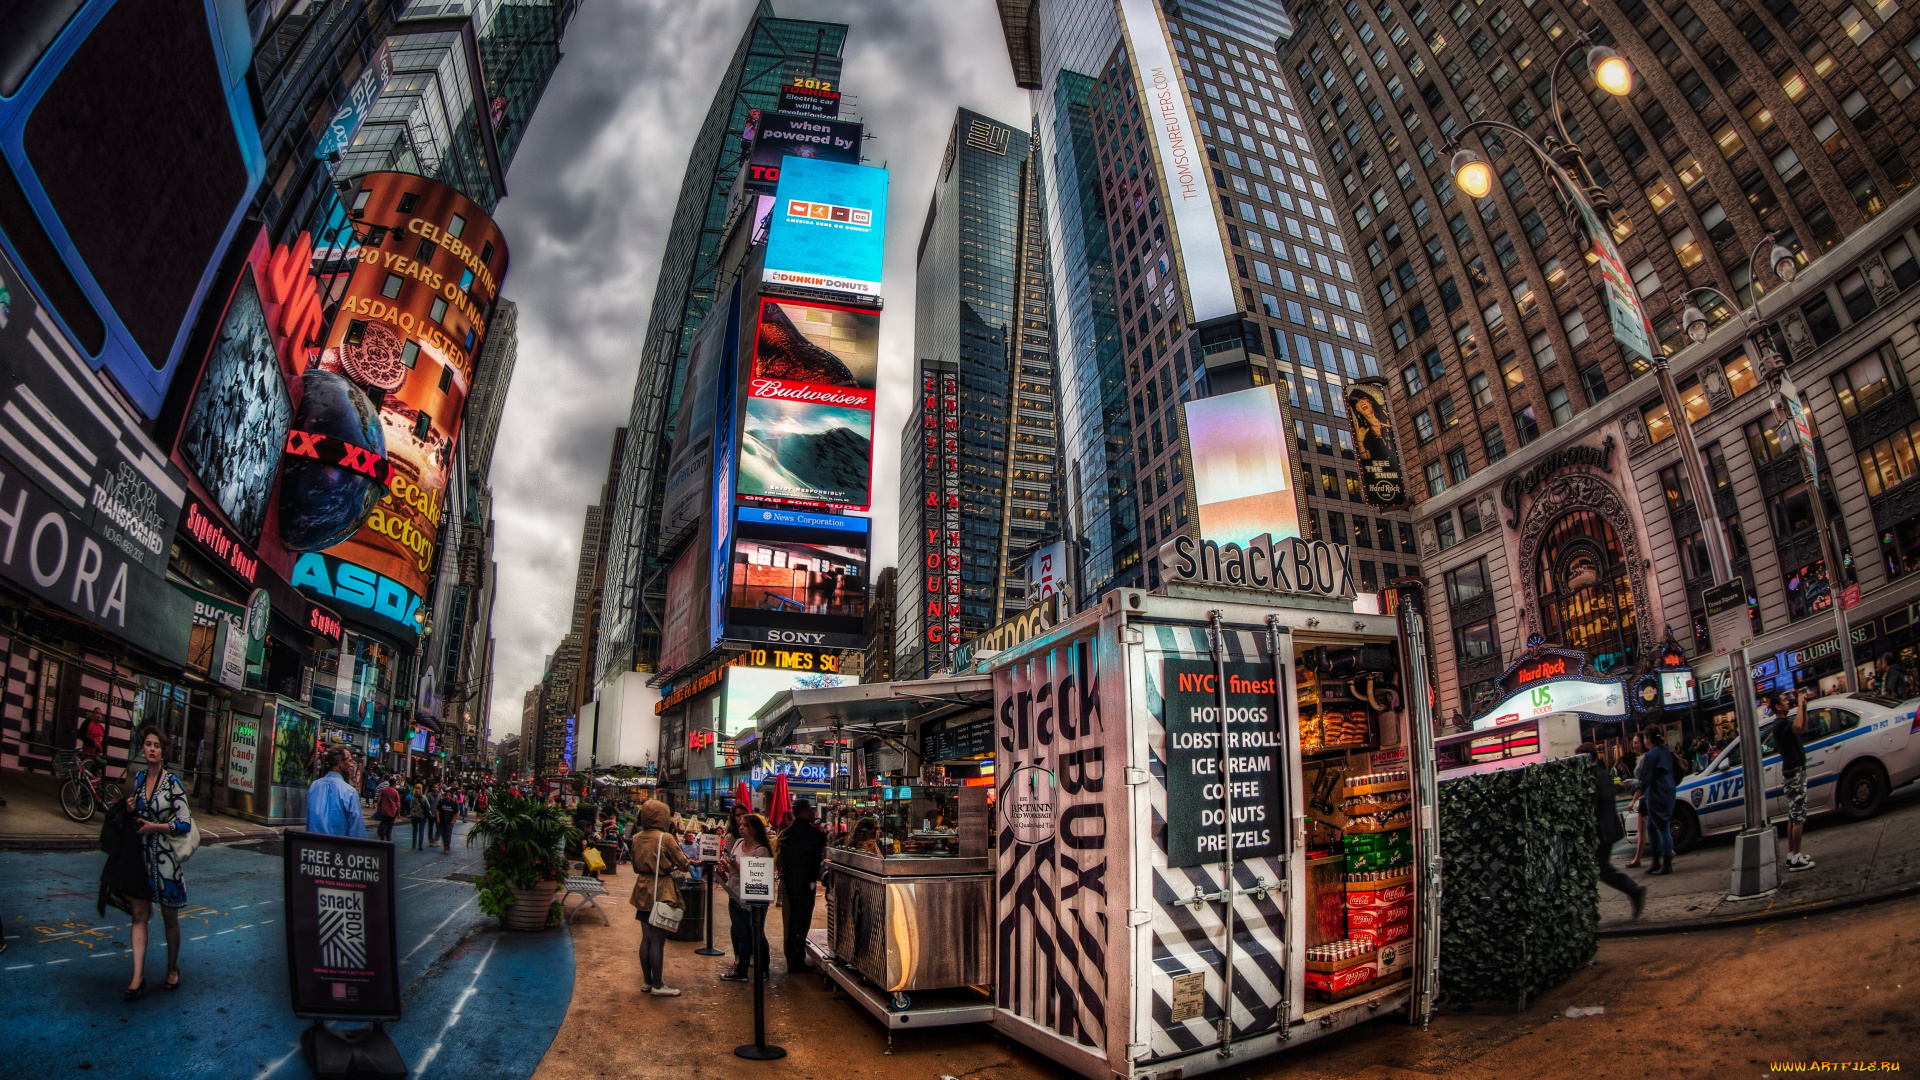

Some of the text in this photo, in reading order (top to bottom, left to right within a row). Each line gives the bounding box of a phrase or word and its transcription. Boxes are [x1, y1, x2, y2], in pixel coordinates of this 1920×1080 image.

[782, 85, 840, 99] TOSHIBA
[794, 77, 831, 91] 2012
[786, 94, 818, 103] Electric
[790, 120, 831, 133] when
[1151, 67, 1197, 201] THOMSONREUTERS.COM
[763, 129, 853, 149] powered by
[786, 218, 814, 226] AMERICA
[408, 218, 496, 299] CELEBRATING
[358, 247, 379, 265] 20
[384, 251, 443, 291] YEARS
[444, 281, 466, 311] ON
[416, 320, 464, 370] LISTED
[752, 379, 867, 406] Budweiser
[117, 461, 158, 512] SEPHORA
[769, 485, 792, 493] ENJOY
[1369, 484, 1400, 493] Hard Rock
[1501, 435, 1615, 529] Paramount
[745, 495, 782, 503] GRAB
[92, 483, 163, 555] TRANSFORMED
[925, 378, 942, 643] ERNST & YOUNG
[773, 513, 844, 527] News Corporation
[103, 525, 133, 555] NOVEMBER
[187, 503, 231, 560] Superior
[1708, 593, 1738, 608] Times Square
[195, 601, 243, 628] BUCKS
[767, 629, 826, 644] SONY
[1794, 628, 1866, 665] CLUBHOSE
[750, 650, 766, 666] TO
[774, 651, 813, 669] TIMES
[1519, 658, 1566, 683] Hard Rock
[1179, 673, 1276, 694] NYC' finest
[1191, 706, 1268, 722] HOT DOGS
[1533, 705, 1552, 716] FOODS
[233, 732, 256, 747] Drink
[238, 726, 254, 736] ATM
[231, 746, 255, 763] Candy
[1371, 749, 1406, 761] CHOKING
[230, 761, 248, 775] Map
[793, 760, 827, 778] YORK
[1192, 758, 1216, 774] ICE
[1706, 778, 1744, 804] NYP
[301, 848, 380, 870] FREE & OPEN
[748, 861, 766, 869] Enter
[300, 864, 380, 883] PUBLIC SEATING
[750, 870, 765, 878] here
[319, 892, 362, 910] snack
[345, 911, 363, 941] BOX
